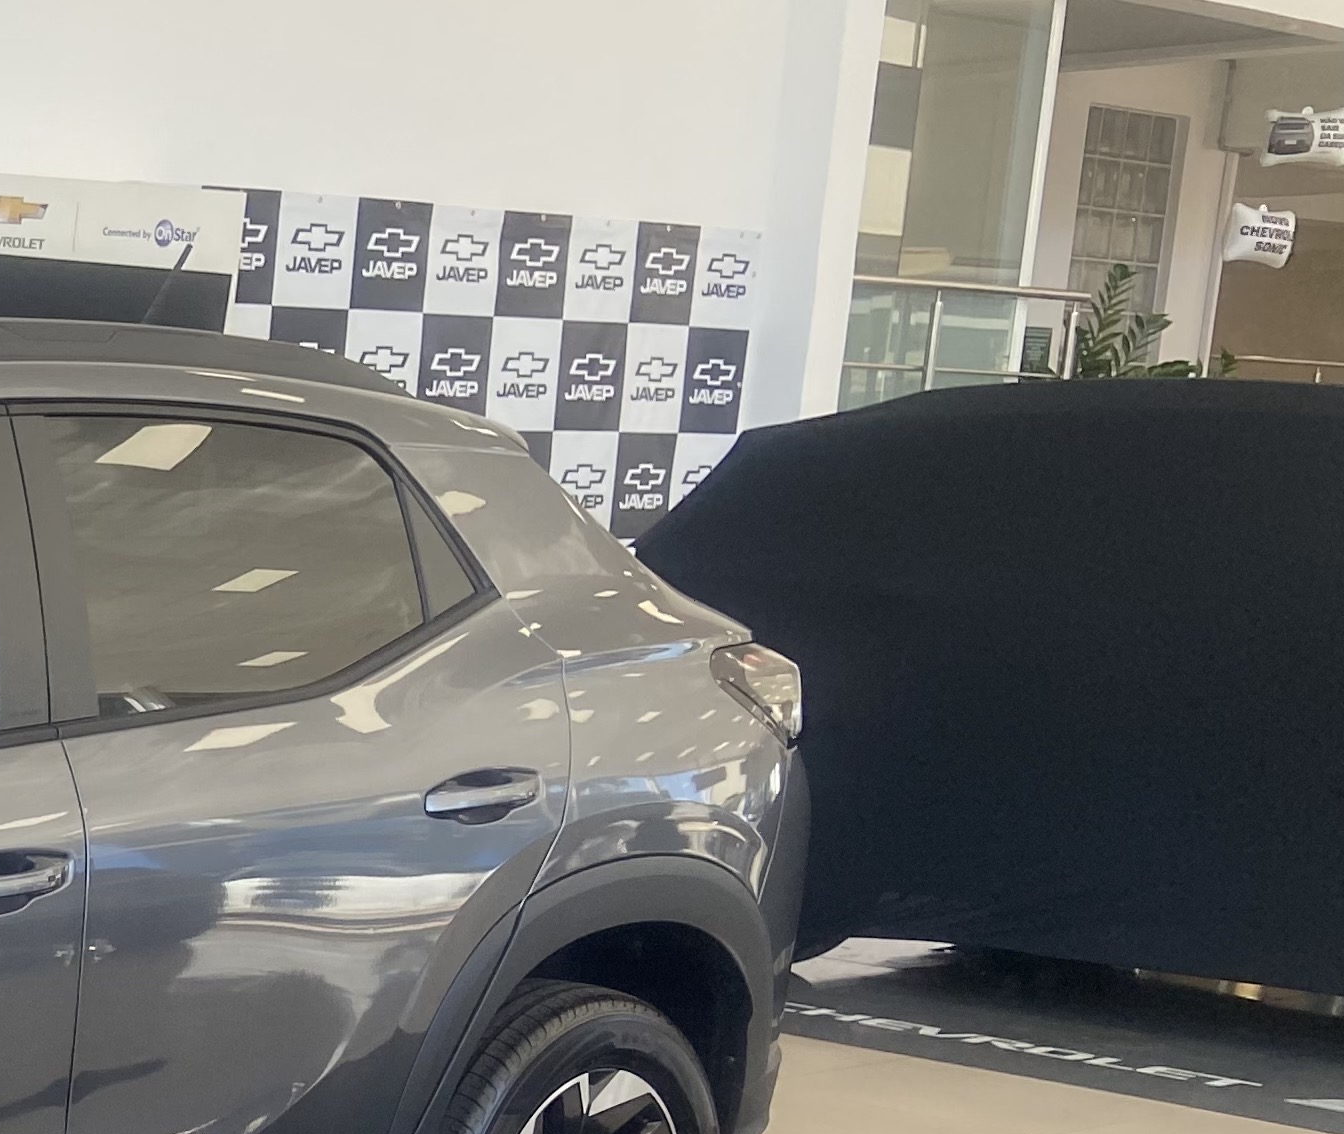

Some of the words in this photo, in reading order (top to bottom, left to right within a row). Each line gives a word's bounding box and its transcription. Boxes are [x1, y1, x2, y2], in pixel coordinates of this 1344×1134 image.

[102, 227, 141, 238] Connected
[142, 229, 151, 241] by
[156, 223, 197, 244] OnStar
[286, 256, 342, 274] JAVEP
[362, 260, 418, 279] JAVEP
[436, 266, 488, 283] JAVEP
[506, 270, 557, 289] JAVEP
[576, 274, 623, 291] JAVEP
[640, 278, 687, 296] JAVEP
[701, 283, 746, 299] JAVEP
[425, 380, 479, 398] JAVEP
[496, 383, 547, 399] JAVEP
[564, 384, 614, 401] JAVEP
[631, 387, 675, 402] JAVEP
[689, 389, 733, 405] JAVEP
[619, 494, 663, 510] JAVEP
